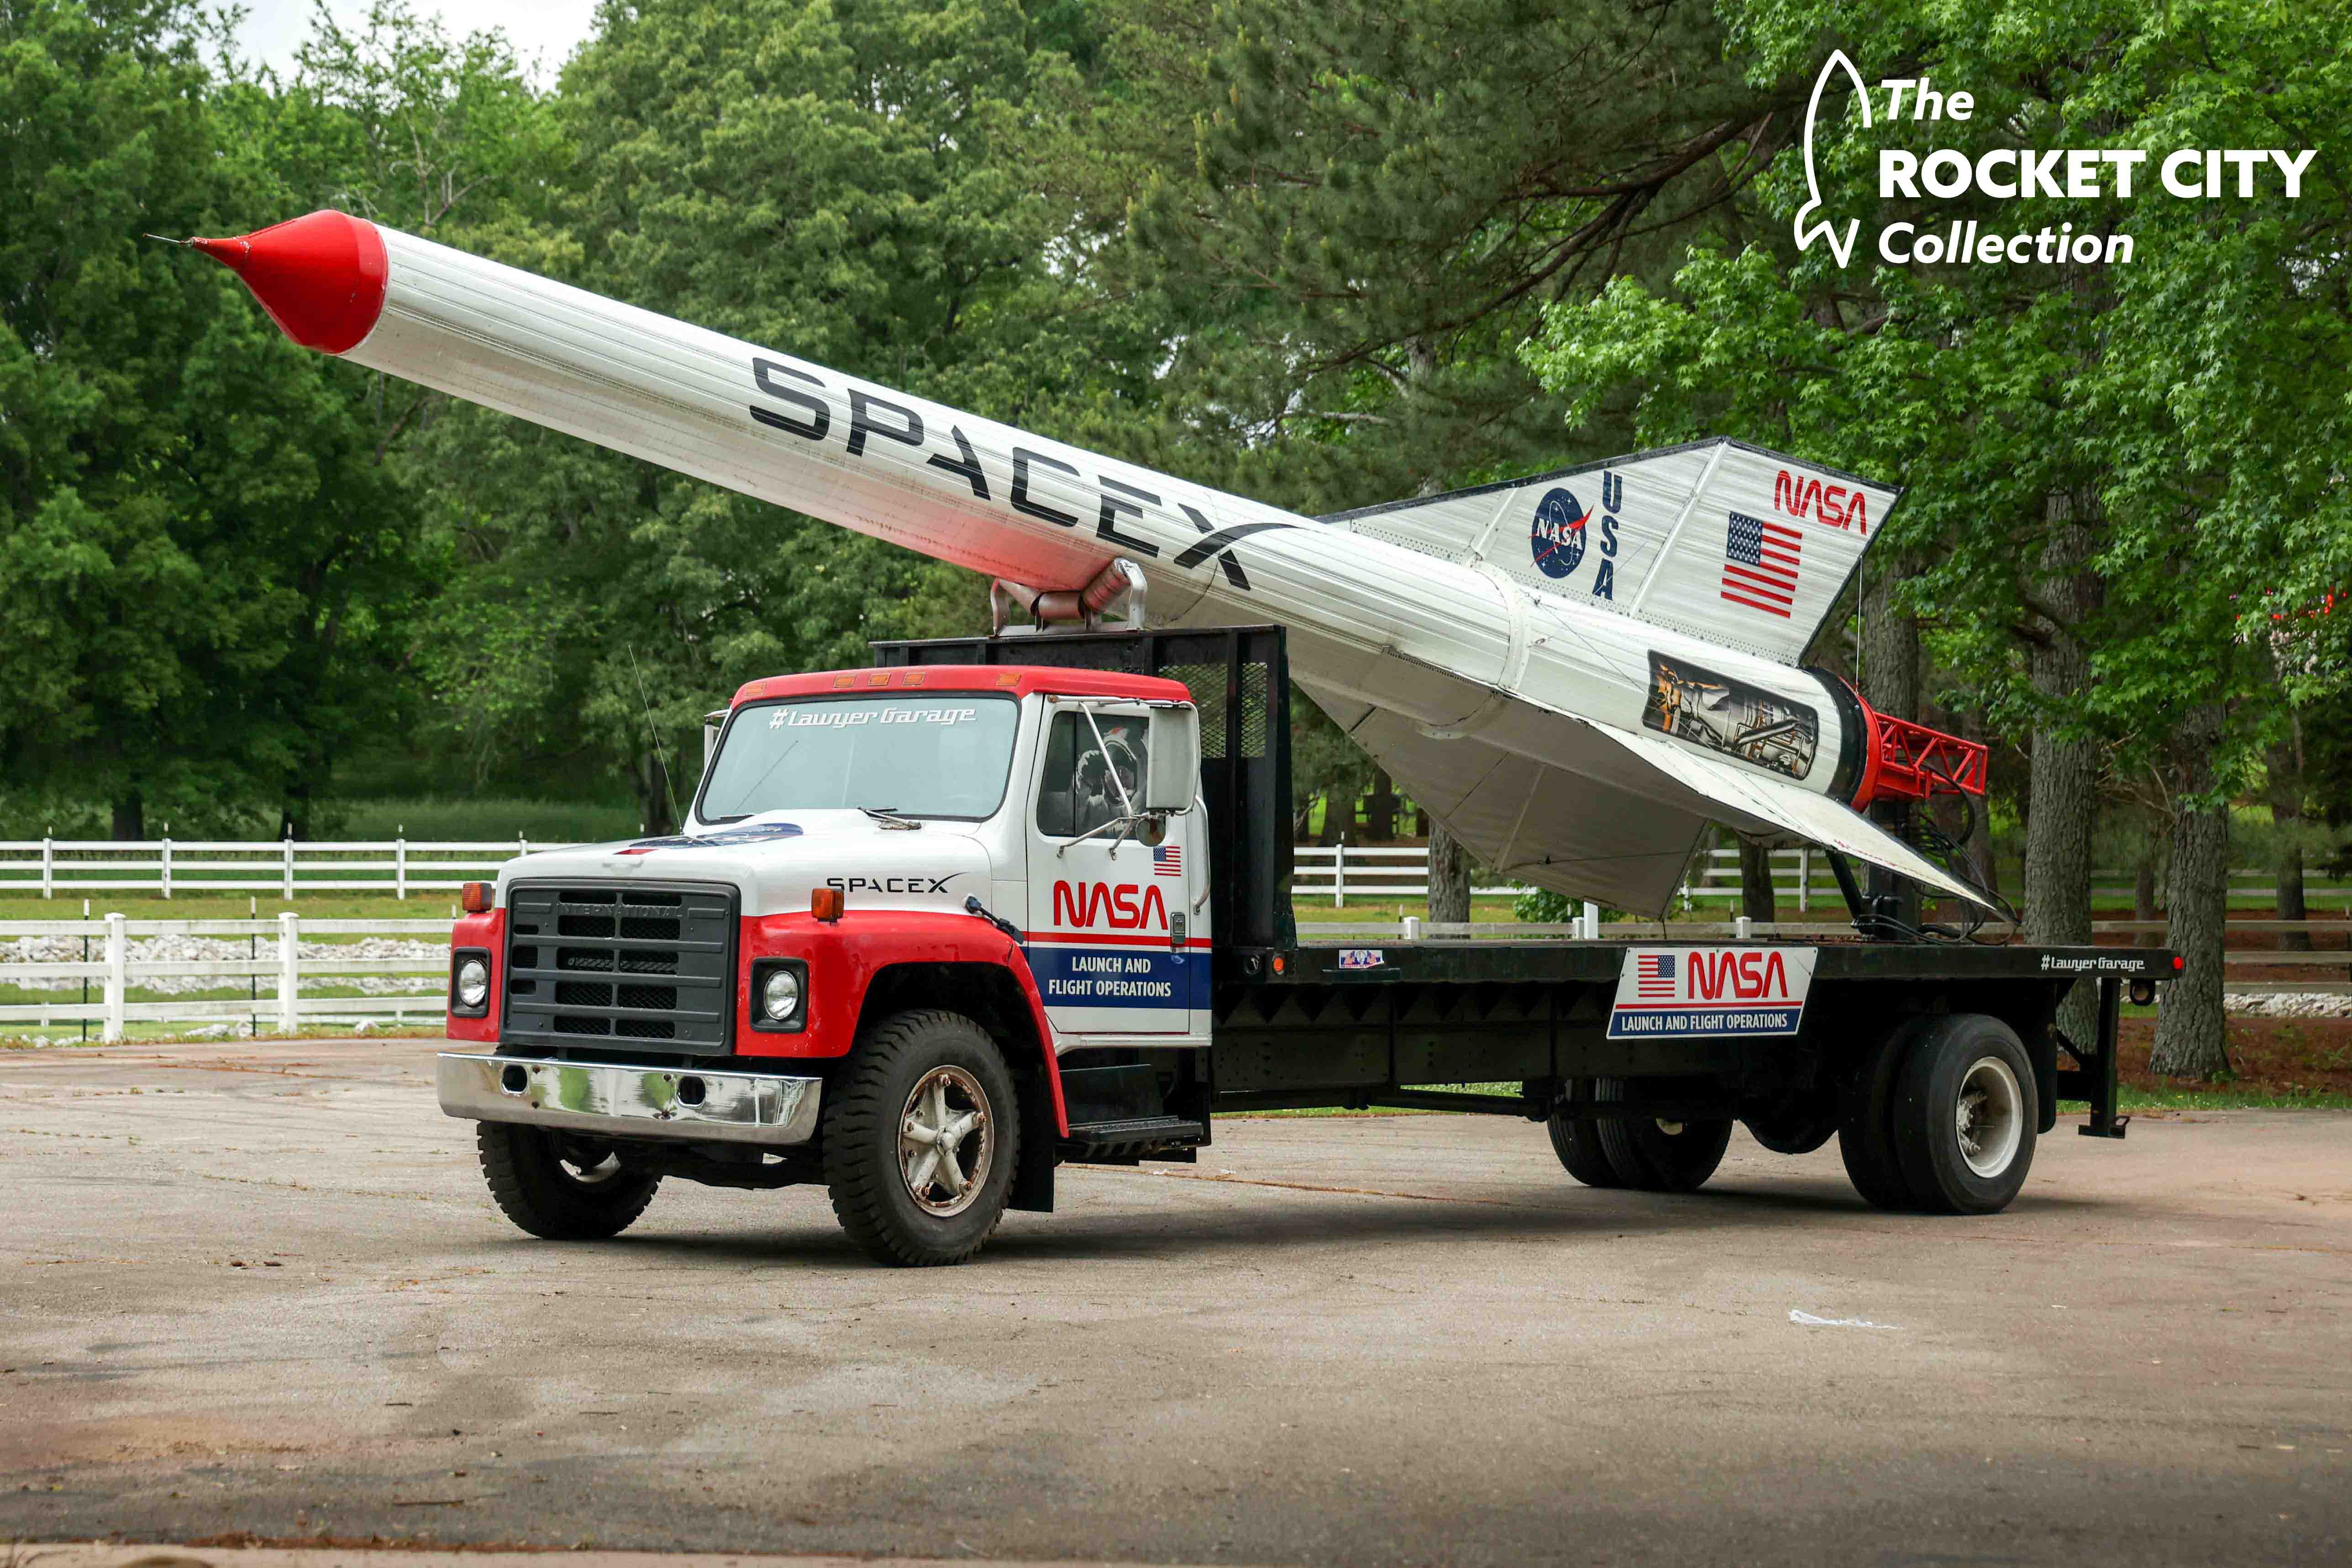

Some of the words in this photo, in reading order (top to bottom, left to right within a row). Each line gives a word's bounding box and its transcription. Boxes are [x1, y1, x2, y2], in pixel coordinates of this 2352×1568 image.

[749, 357, 1304, 591] SPACEX
[1774, 470, 1867, 535] NASA
[1537, 518, 1583, 551] NASA
[1592, 470, 1622, 601] USA
[827, 871, 970, 893] SPACEX
[1053, 880, 1168, 930] NASA
[1072, 956, 1122, 973] LAUNCH
[1124, 958, 1151, 973] AND
[1688, 951, 1788, 999] NASA
[1049, 979, 1092, 995] FLIGHT
[1096, 981, 1171, 997] OPERATIONS
[1622, 1016, 1663, 1031] LAUNCH
[1665, 1016, 1687, 1030] AND
[1690, 1015, 1724, 1029] FLIGHT
[1726, 1013, 1787, 1029] OPERATIONS
